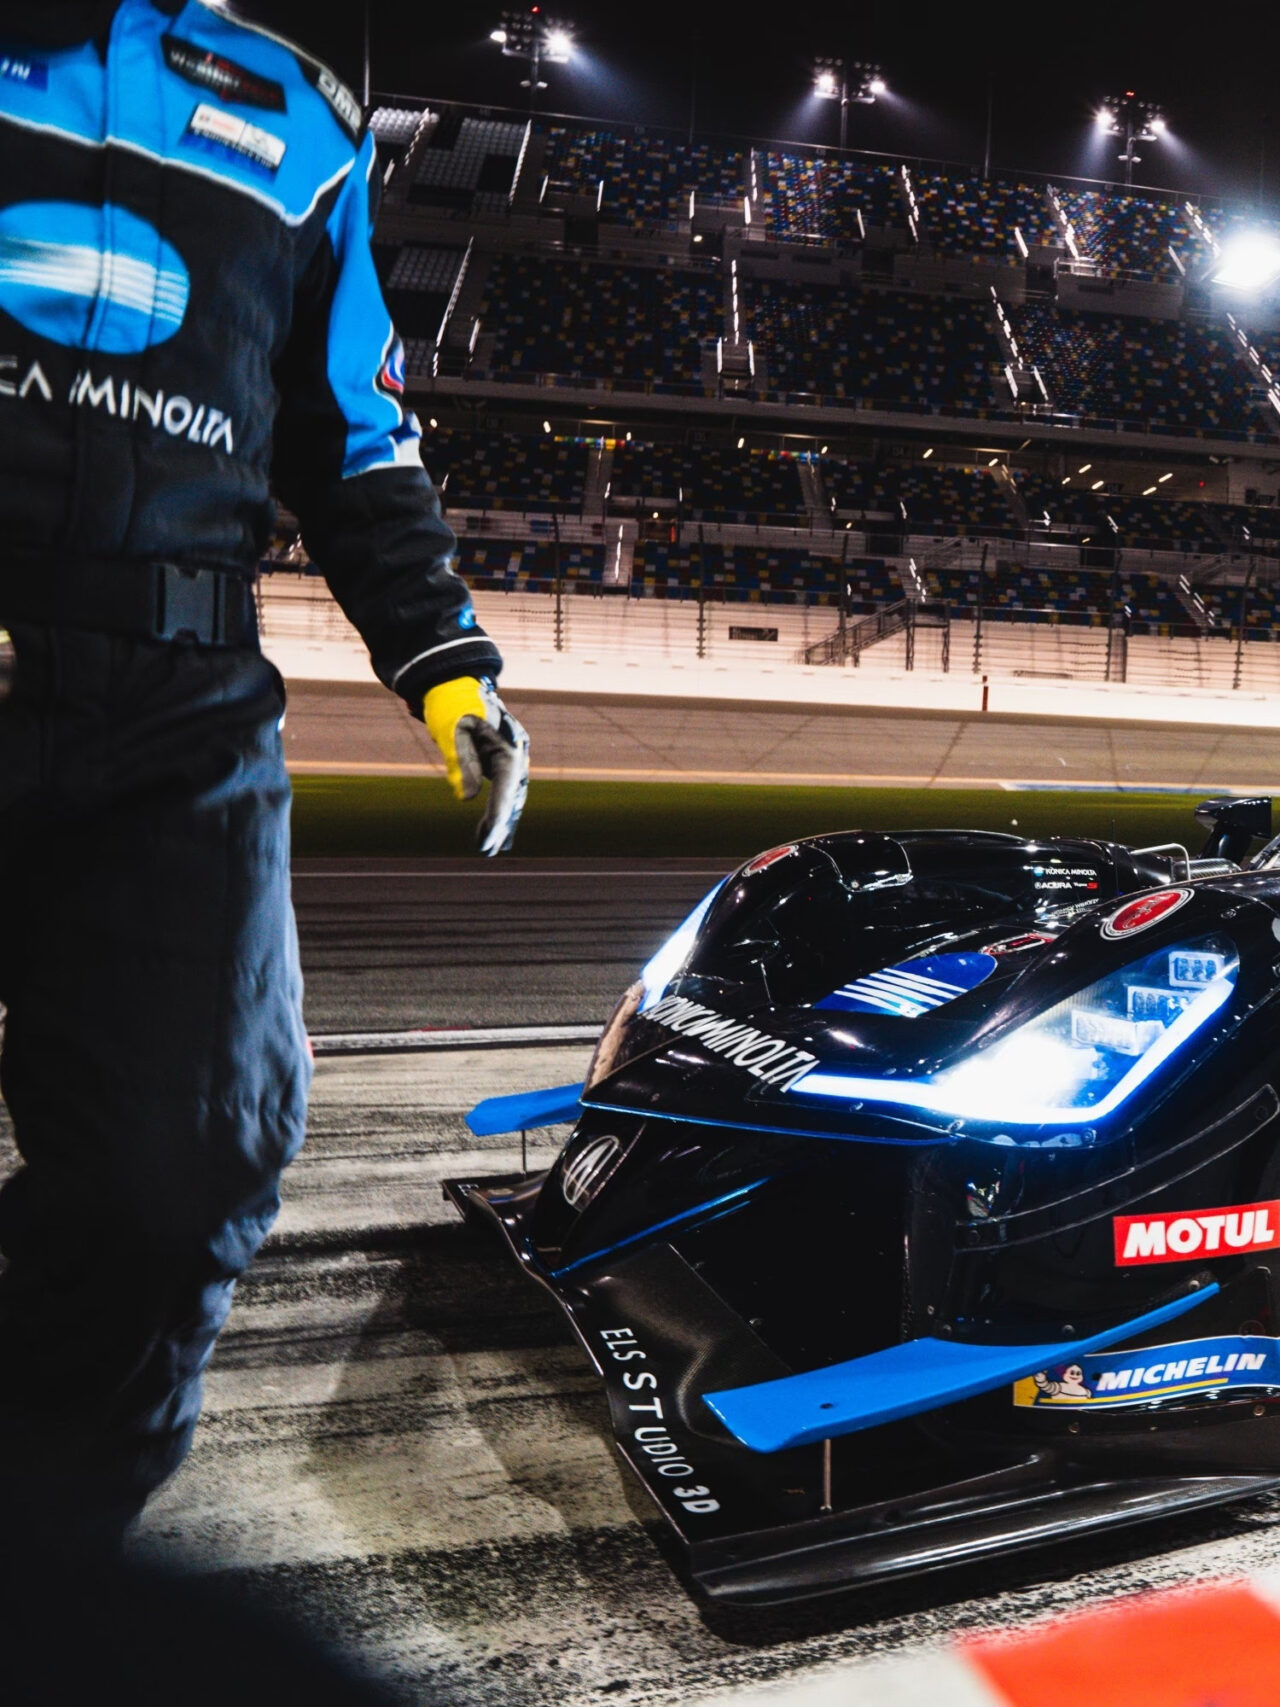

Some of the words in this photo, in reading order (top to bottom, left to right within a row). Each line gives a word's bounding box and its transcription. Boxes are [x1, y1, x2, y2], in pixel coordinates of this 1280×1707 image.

[69, 370, 234, 455] MINOLTA
[699, 1018, 820, 1093] MINOLTA
[1123, 1209, 1275, 1258] MOTUL
[1096, 1353, 1267, 1391] MICHELIN
[600, 1328, 647, 1361] ELS
[673, 1485, 720, 1513] 3D
